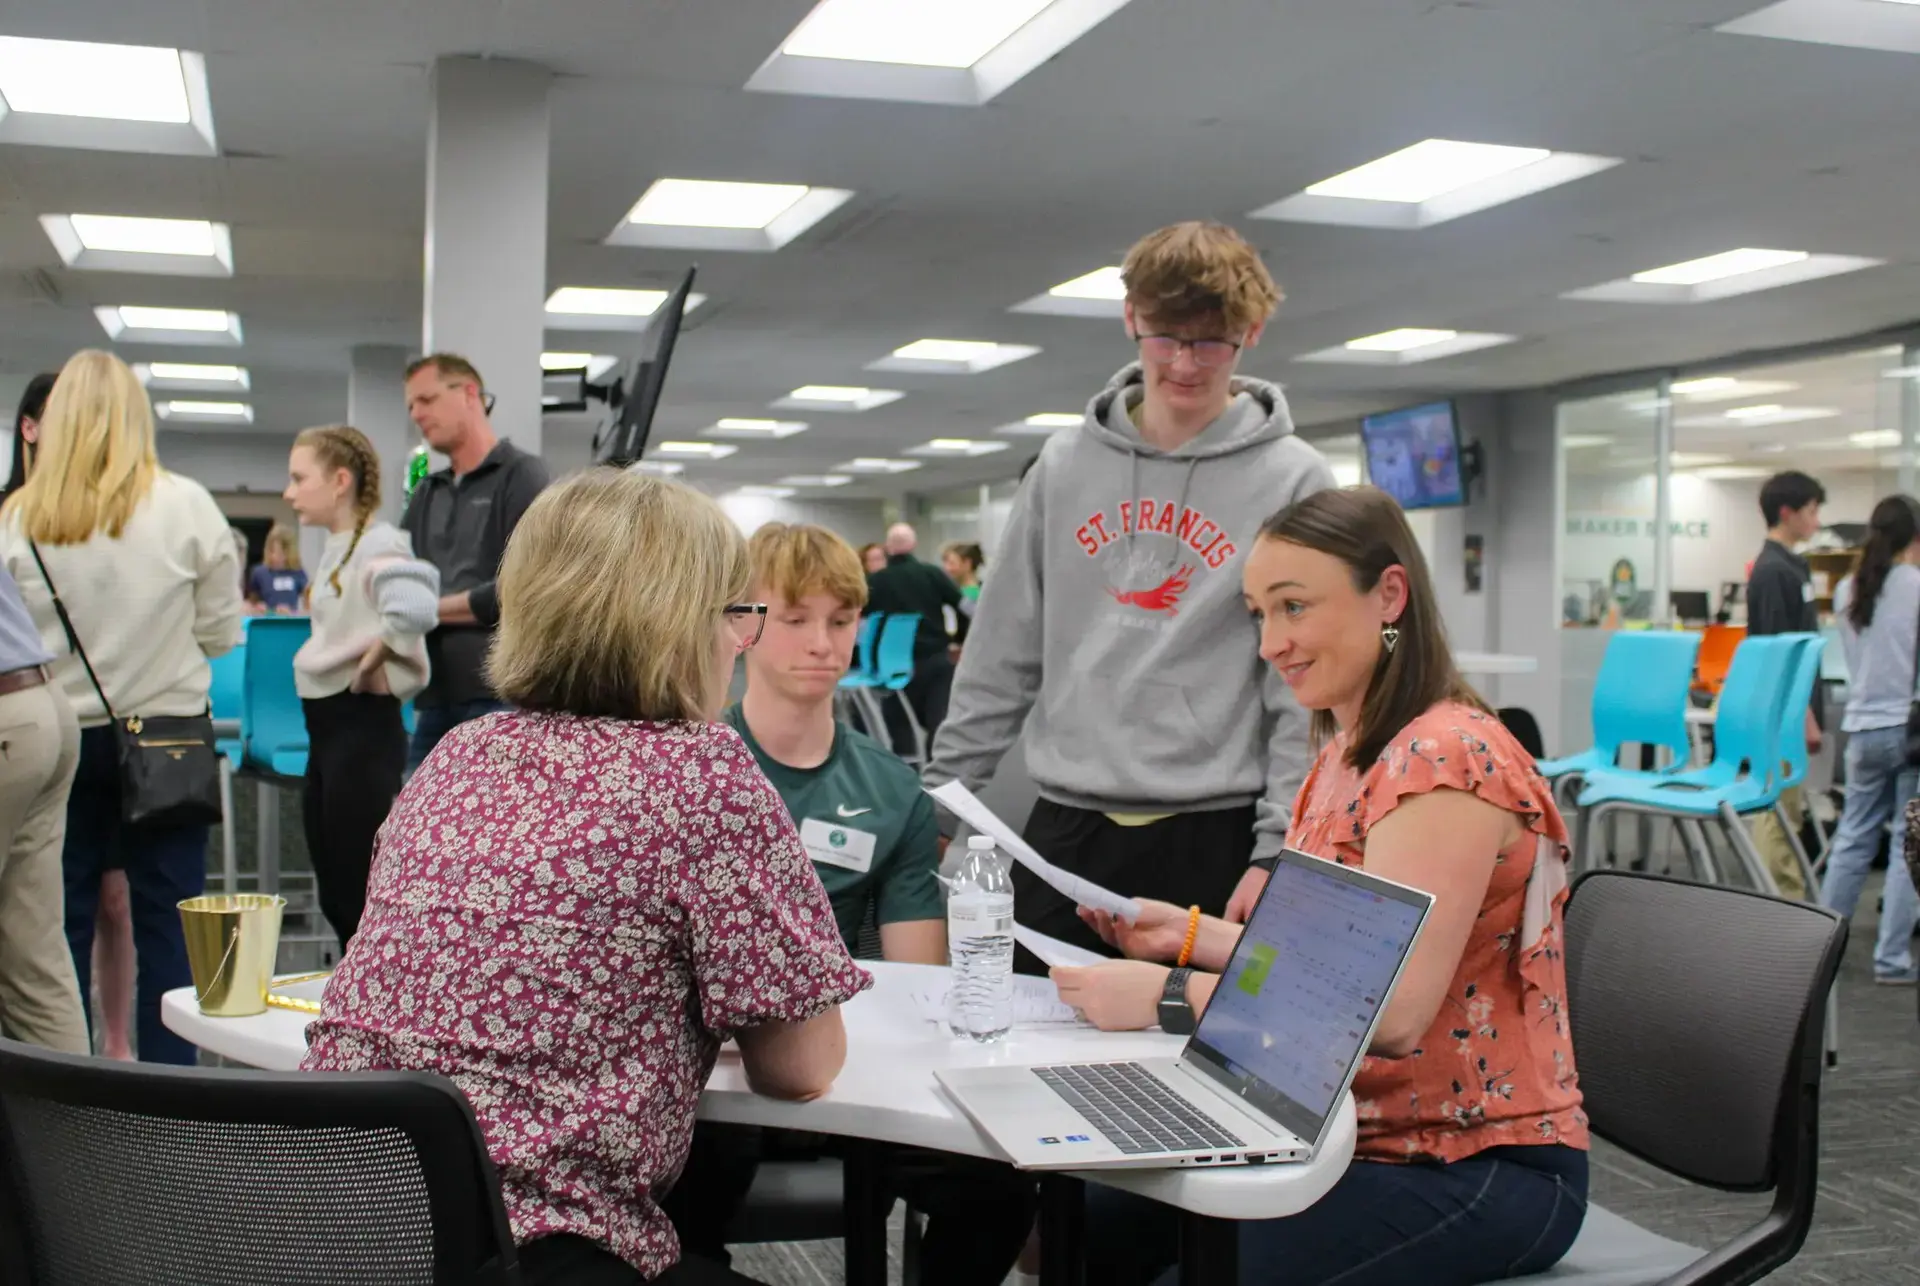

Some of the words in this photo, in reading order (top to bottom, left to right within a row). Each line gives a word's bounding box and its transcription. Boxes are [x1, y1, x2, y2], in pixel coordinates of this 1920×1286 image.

[1075, 511, 1119, 558] ST.
[1119, 499, 1238, 572] FRANCIS
[1566, 519, 1638, 537] MAKER
